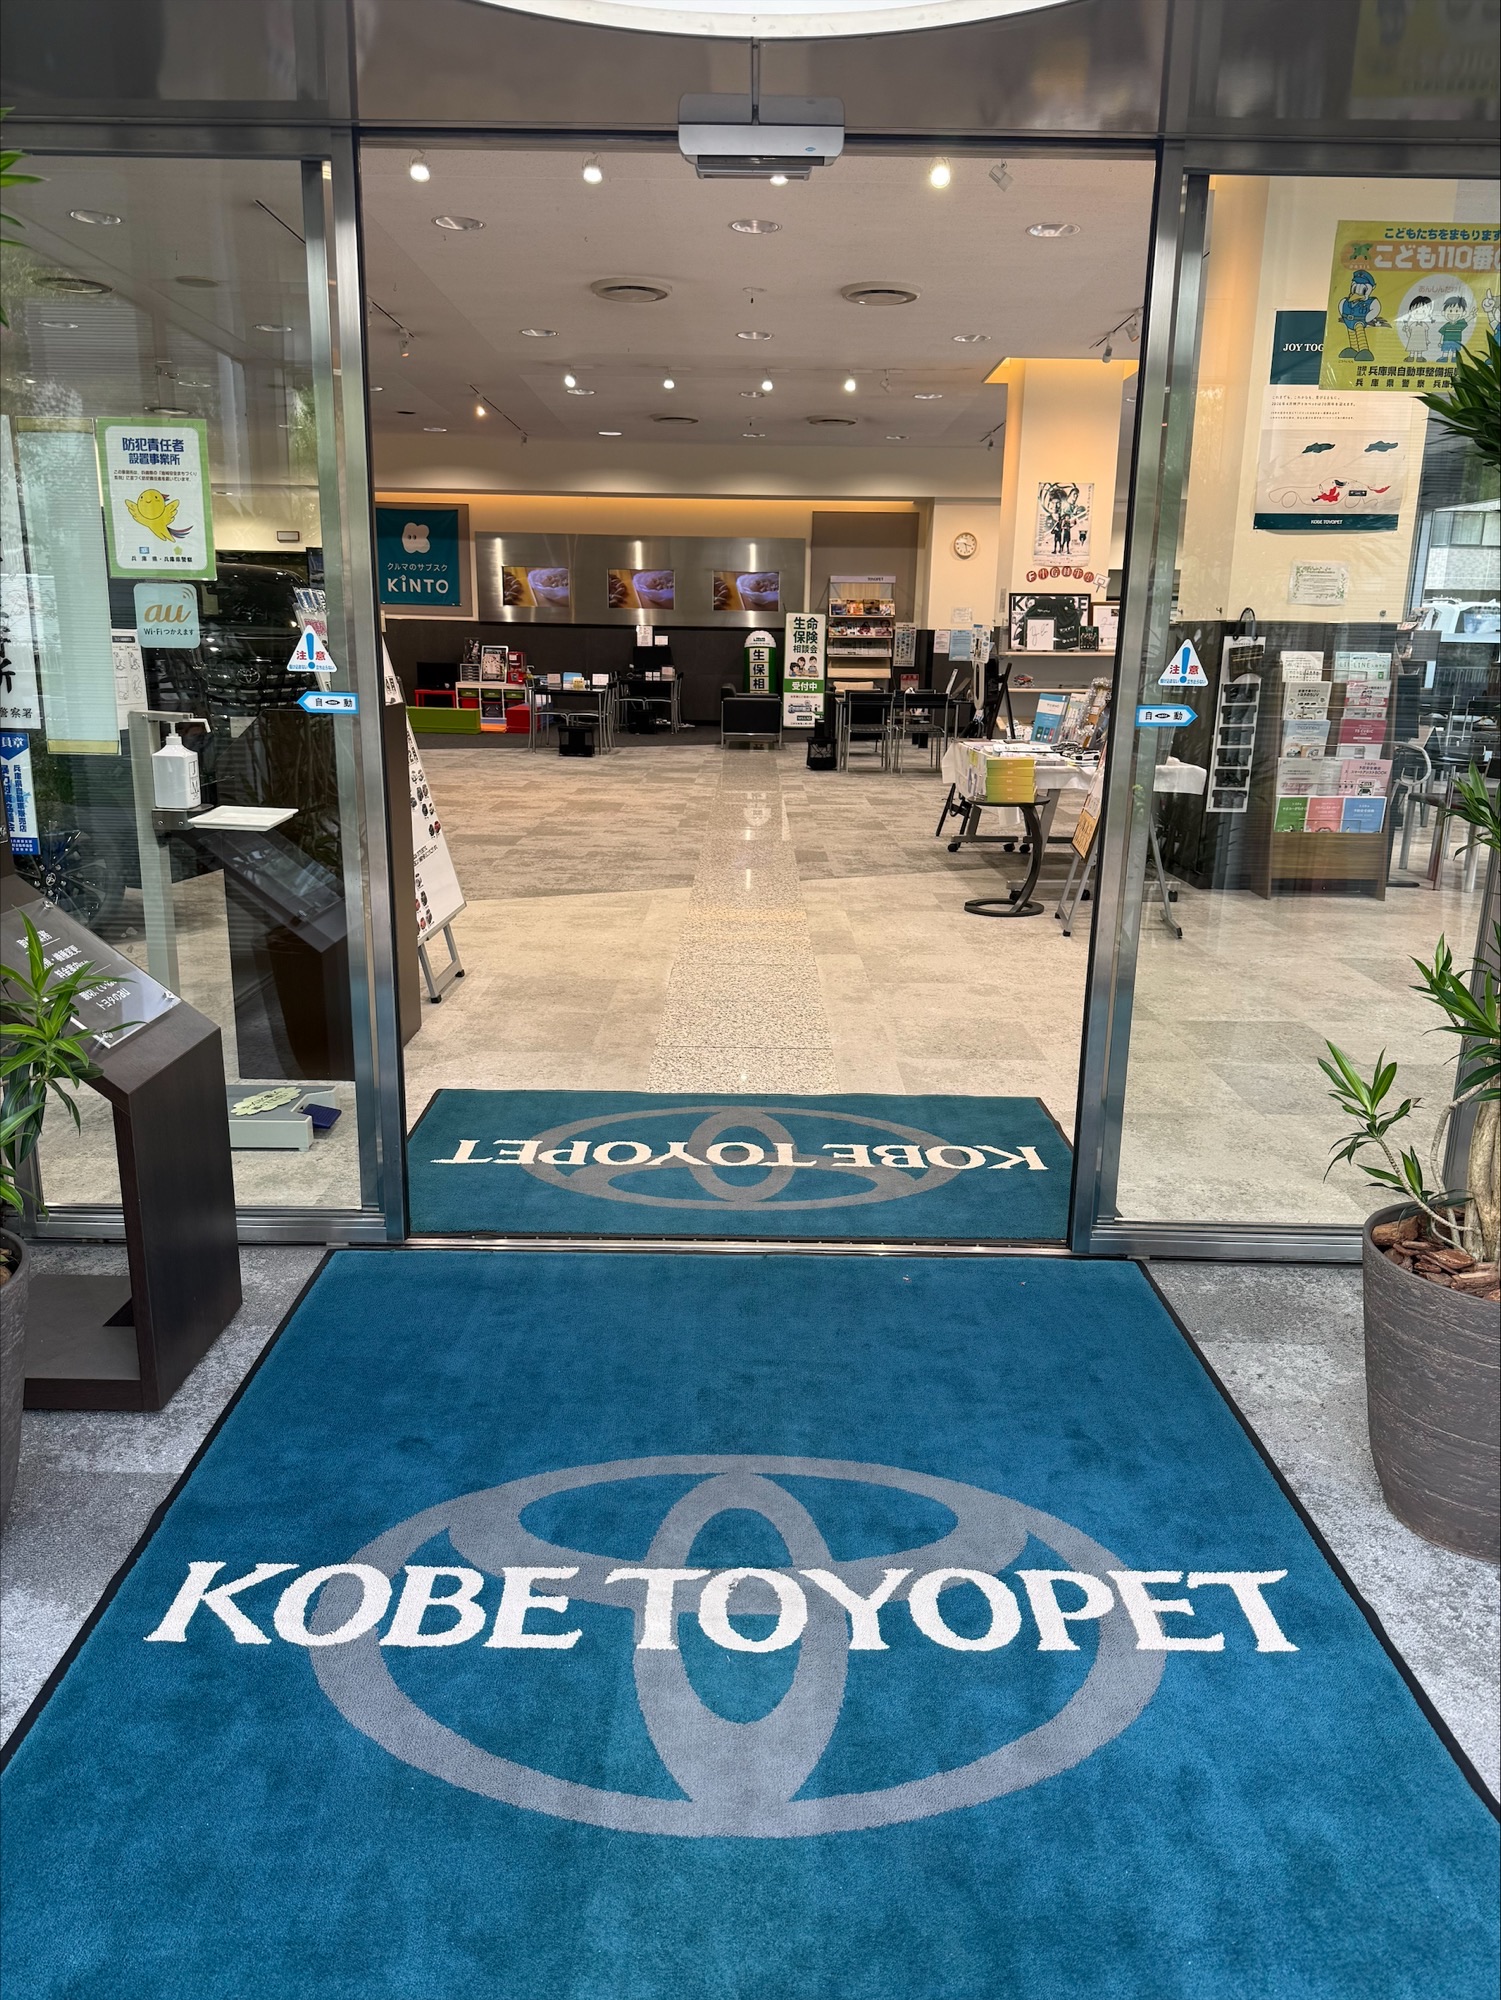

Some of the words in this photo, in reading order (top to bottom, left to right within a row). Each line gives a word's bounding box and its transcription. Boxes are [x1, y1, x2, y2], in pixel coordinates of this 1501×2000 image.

[1283, 343, 1303, 352] JOY
[122, 437, 185, 453] 防犯責任者
[128, 453, 181, 466] 設置事業所
[387, 562, 448, 572] クルマのサブスク
[144, 604, 192, 624] au
[793, 616, 819, 630] 生命
[793, 630, 819, 644] 保険
[793, 644, 819, 654] 相談会
[752, 649, 766, 693] 生保相
[791, 681, 818, 692] 受付中
[431, 1139, 816, 1168] TOYOPET
[832, 1143, 1050, 1171] KOBE
[143, 1561, 583, 1649] KOBE
[605, 1566, 1300, 1653] TOYOPET
